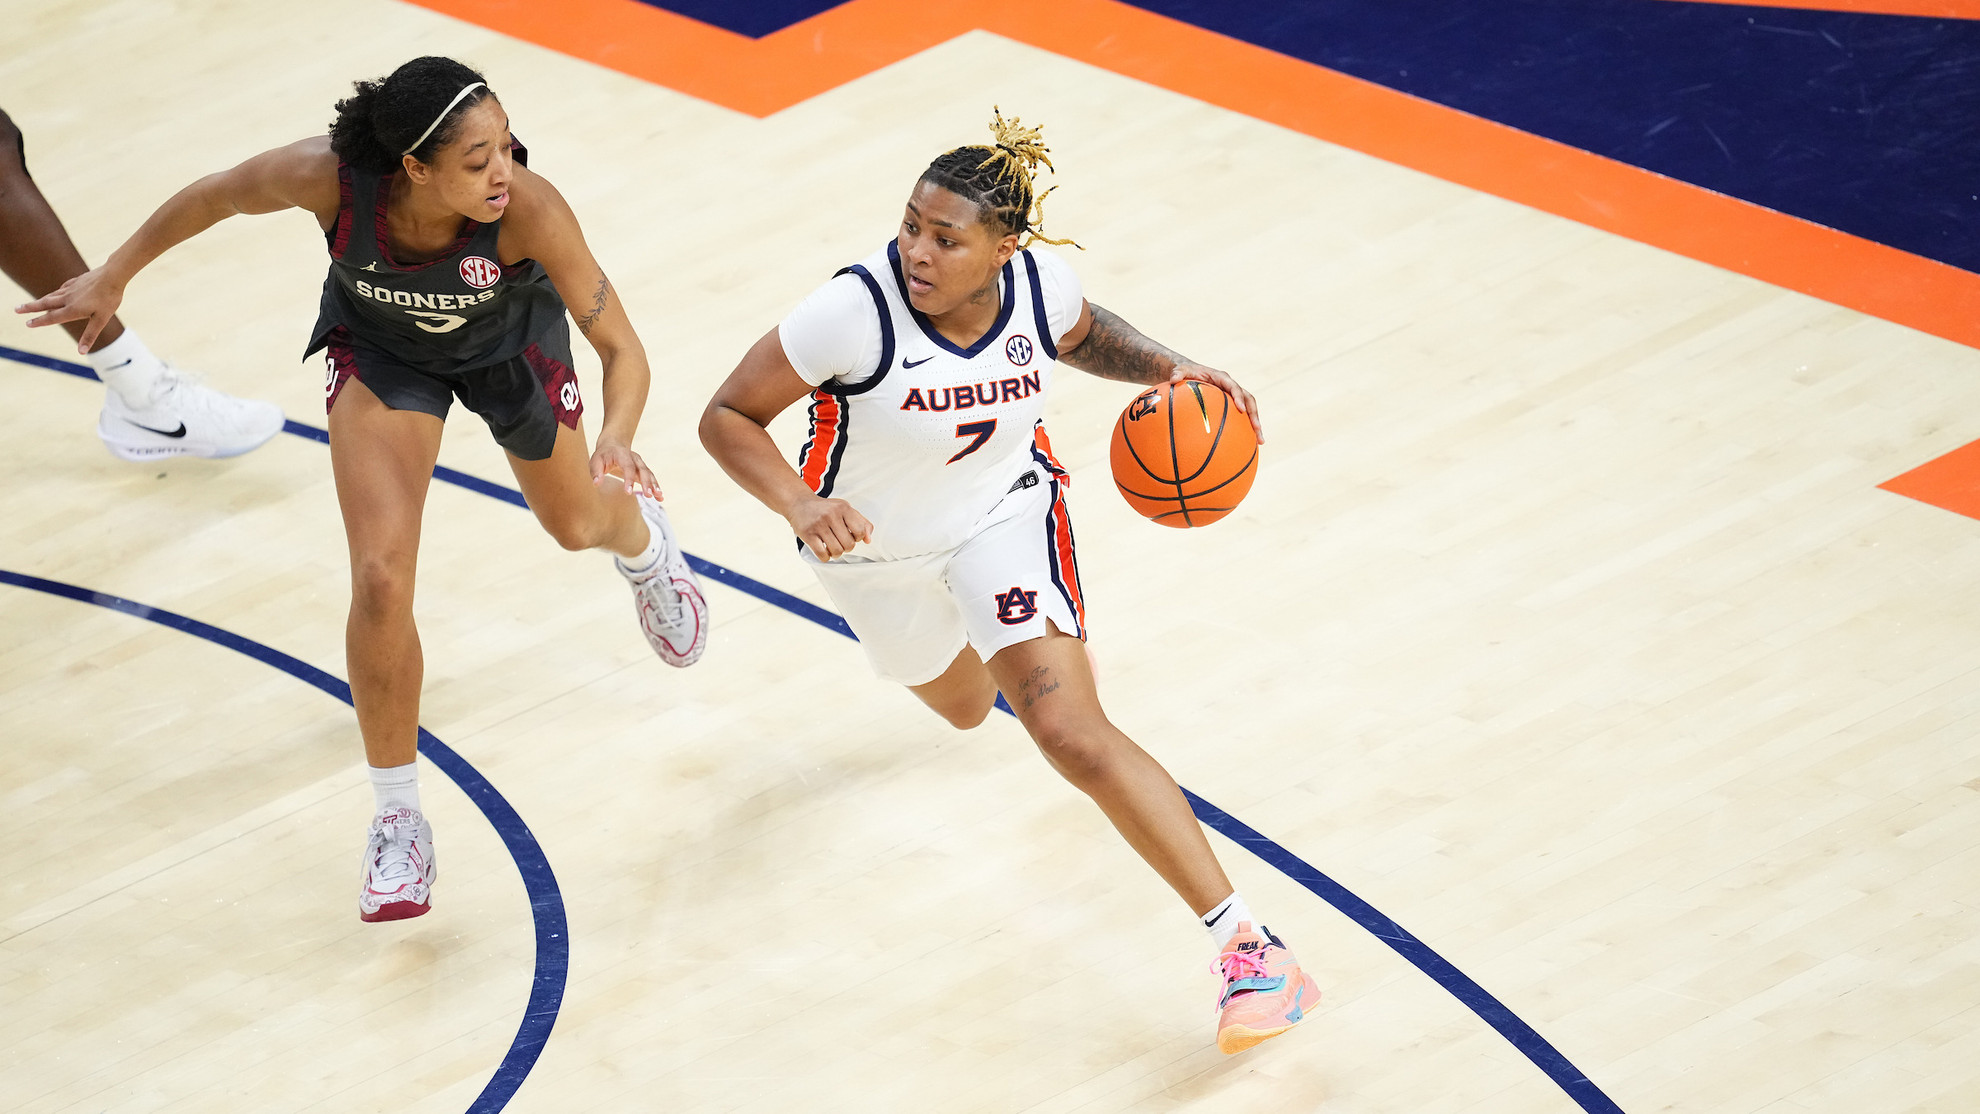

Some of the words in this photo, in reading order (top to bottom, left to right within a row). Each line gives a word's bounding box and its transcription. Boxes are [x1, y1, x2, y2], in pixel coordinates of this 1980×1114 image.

[462, 258, 497, 286] SEC
[356, 280, 495, 310] SOONERS
[1007, 336, 1031, 364] SEC
[900, 369, 1041, 411] AUBURN
[945, 418, 997, 466] 7
[1025, 476, 1036, 486] 46
[994, 586, 1038, 625] AU
[1237, 941, 1259, 951] FREAK
